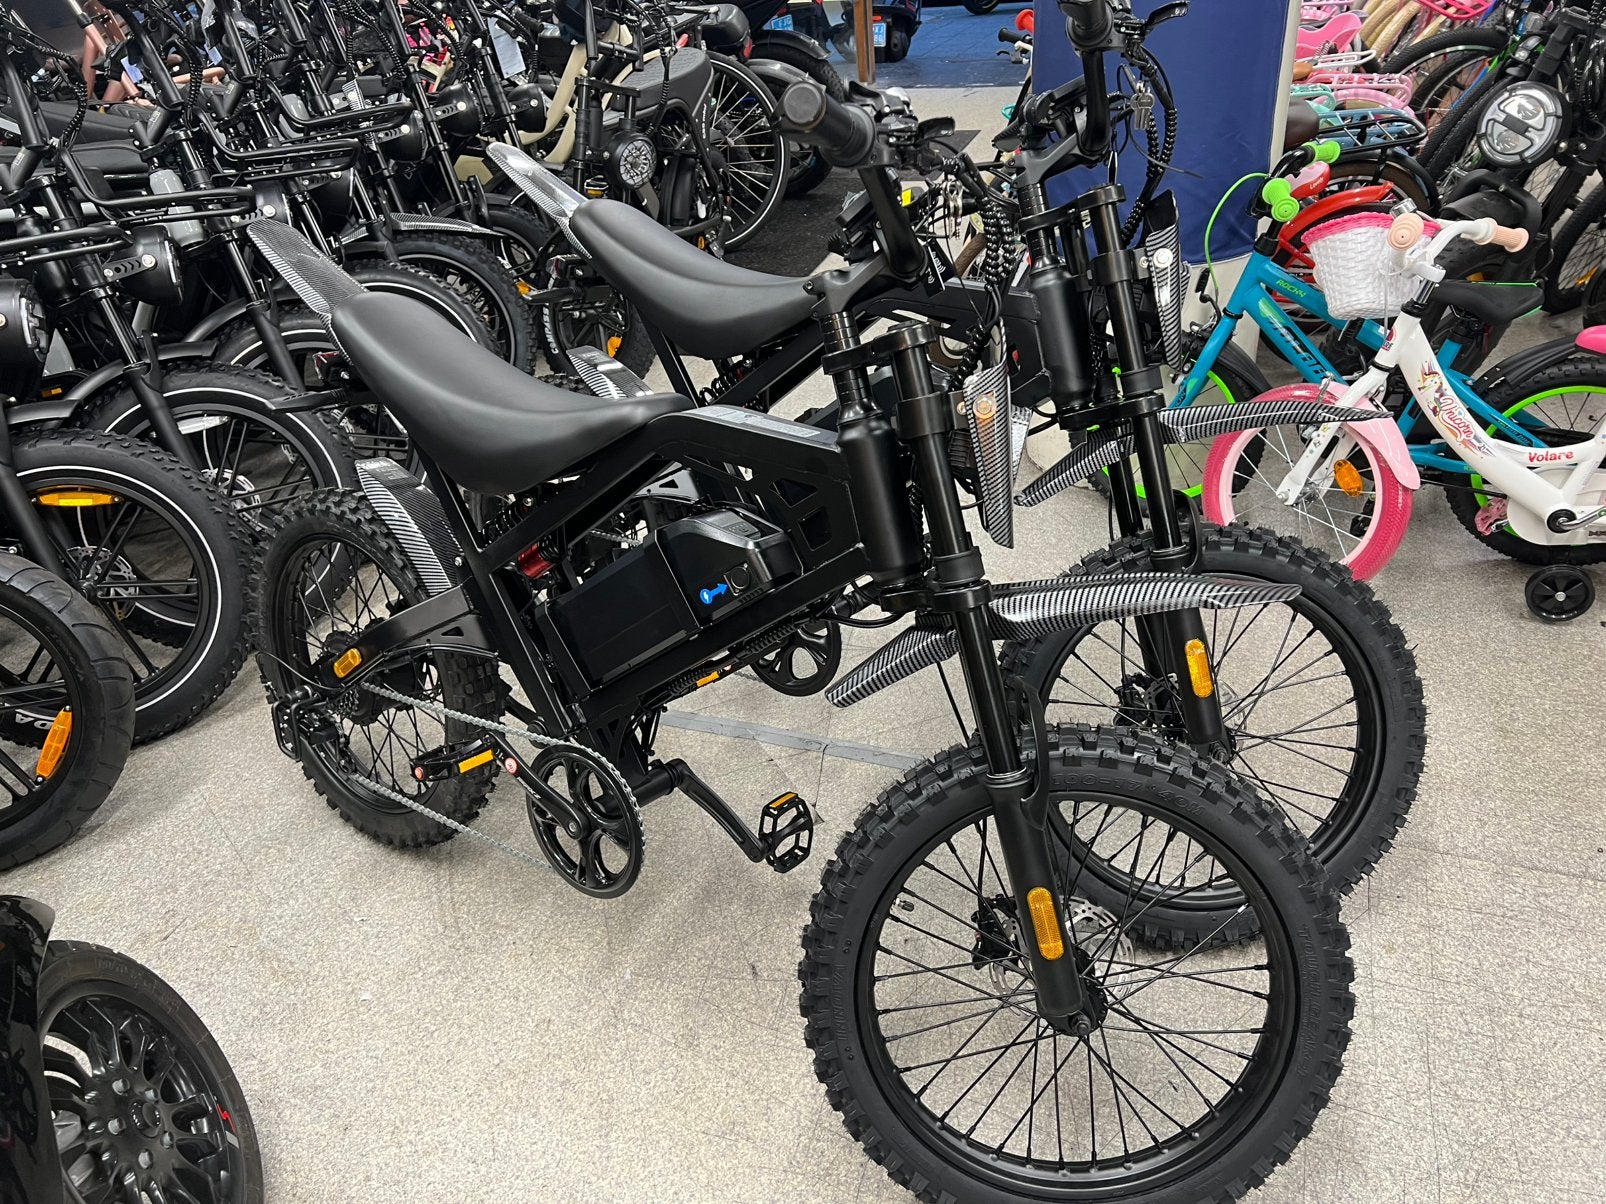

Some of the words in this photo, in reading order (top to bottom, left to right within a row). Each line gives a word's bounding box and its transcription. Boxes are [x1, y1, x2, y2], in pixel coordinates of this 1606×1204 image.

[1275, 279, 1307, 298] ROCKY
[1439, 396, 1474, 440] Unicorn
[1528, 451, 1574, 463] Volare
